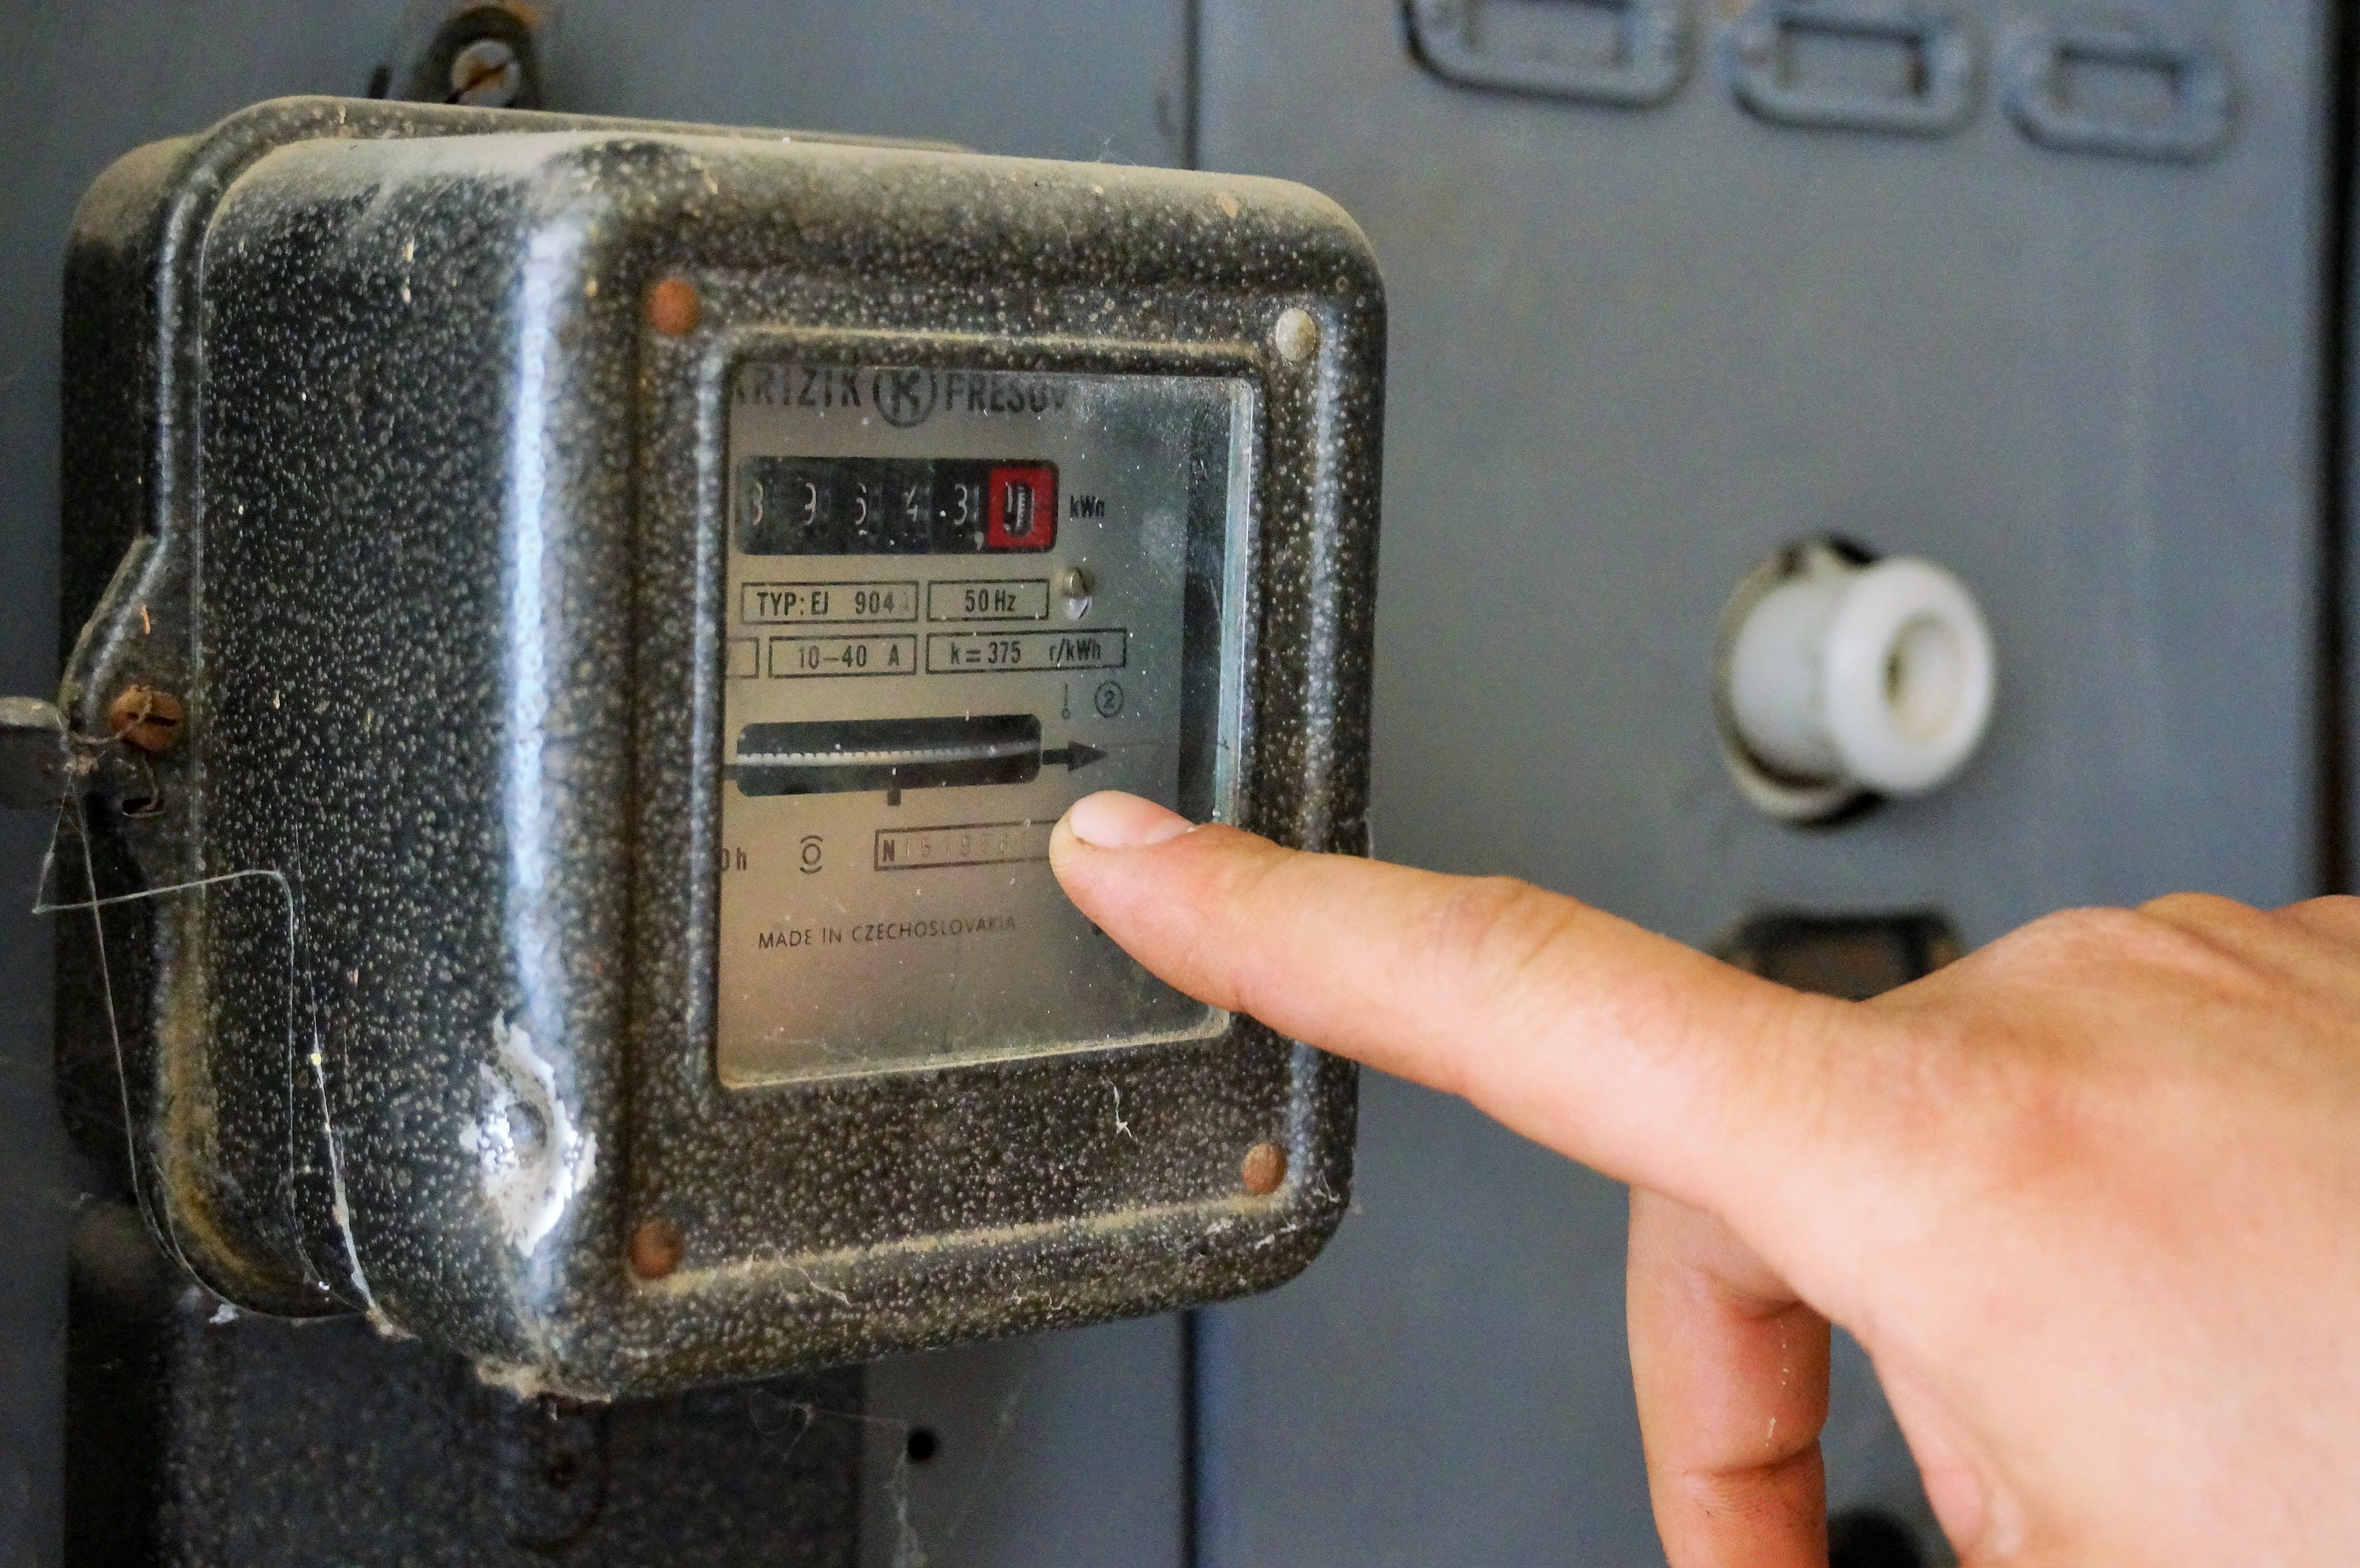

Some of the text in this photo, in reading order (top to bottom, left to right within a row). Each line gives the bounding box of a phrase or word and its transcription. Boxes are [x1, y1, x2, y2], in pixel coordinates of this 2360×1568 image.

[888, 644, 900, 666] A
[758, 915, 1017, 949] MADE IN CZECHOSLOVAKIA
